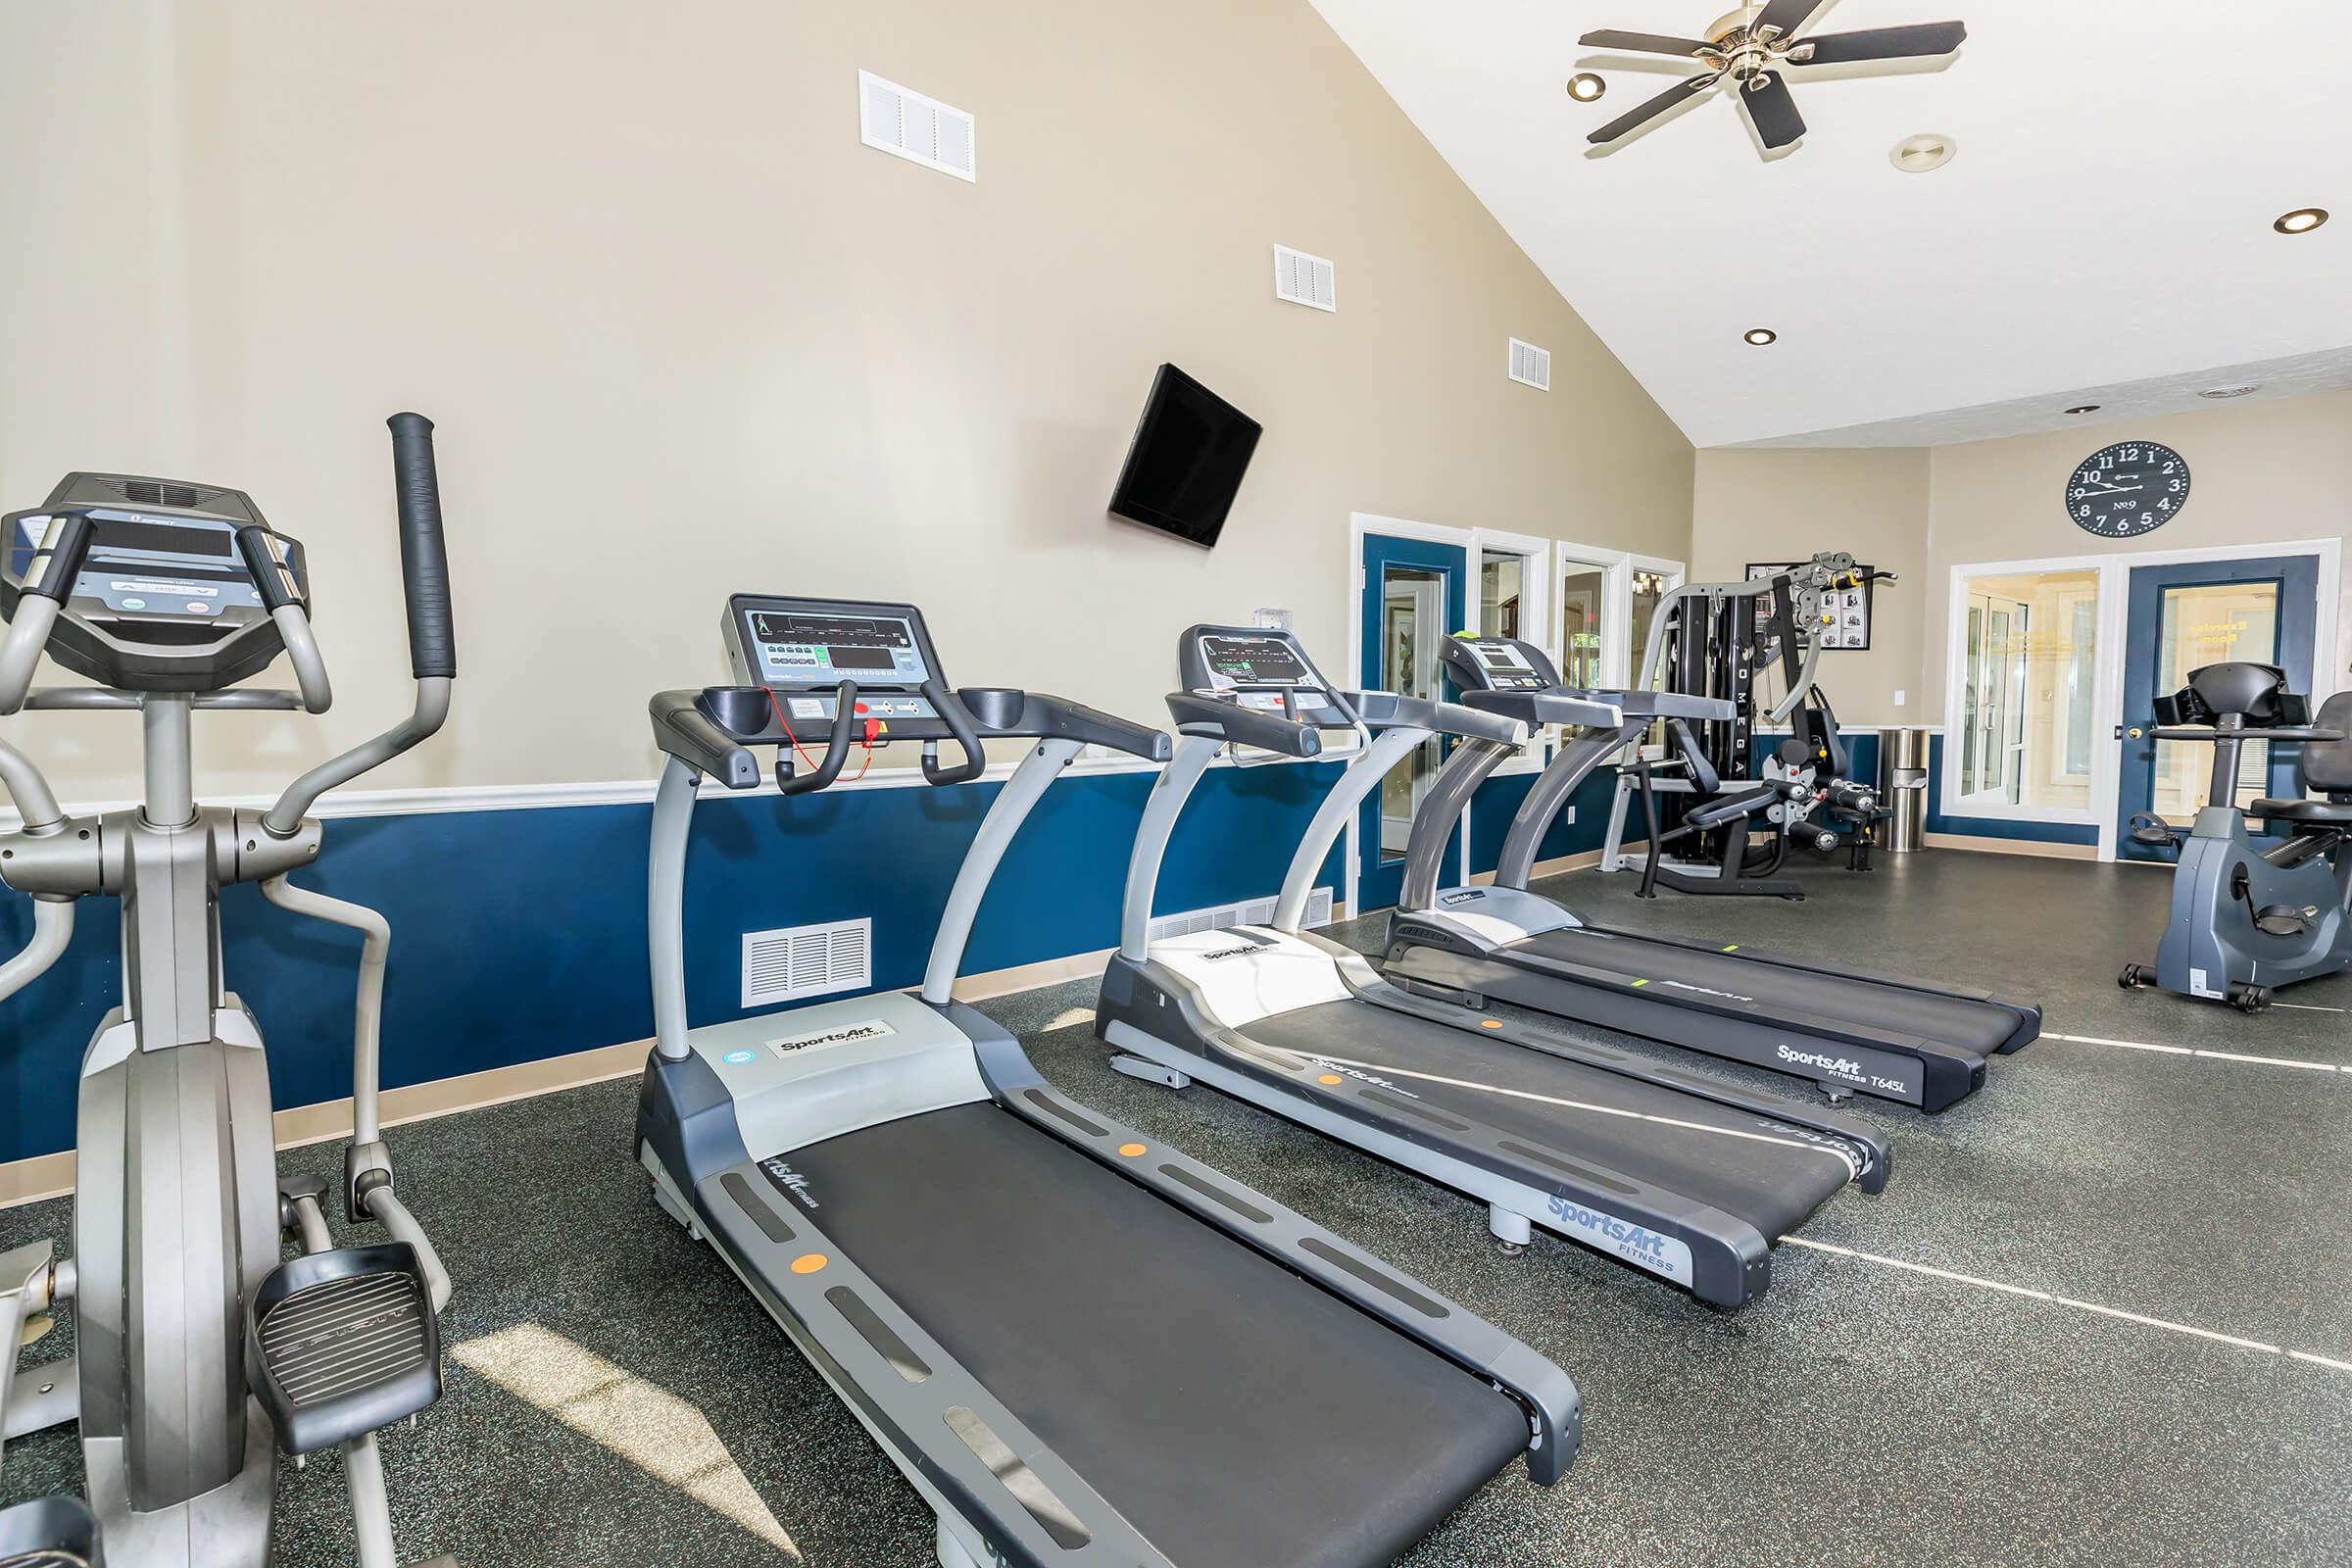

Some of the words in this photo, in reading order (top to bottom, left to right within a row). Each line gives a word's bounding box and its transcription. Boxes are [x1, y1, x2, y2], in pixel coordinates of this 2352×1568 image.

[2119, 448, 2138, 462] 12
[2146, 451, 2156, 464] 1
[2098, 457, 2114, 469] 11
[2162, 462, 2175, 475] 2
[2082, 469, 2101, 484] 10
[2169, 479, 2180, 492] 3
[2074, 487, 2085, 501] 9
[2080, 505, 2091, 516] 8
[2157, 497, 2171, 511] 4
[2095, 514, 2108, 528] 7
[2117, 518, 2130, 531] 6
[2140, 512, 2153, 525] 5
[1736, 668, 1747, 772] OMEGA
[780, 1026, 874, 1051] SportsArt
[1777, 1044, 1861, 1075] SportsArt
[1312, 1057, 1393, 1089] SportsArt
[1828, 1069, 1867, 1083] FITNESS
[1870, 1076, 1907, 1094] T645L
[1547, 1195, 1666, 1256] SportsArt
[1618, 1245, 1675, 1272] FITNESS
